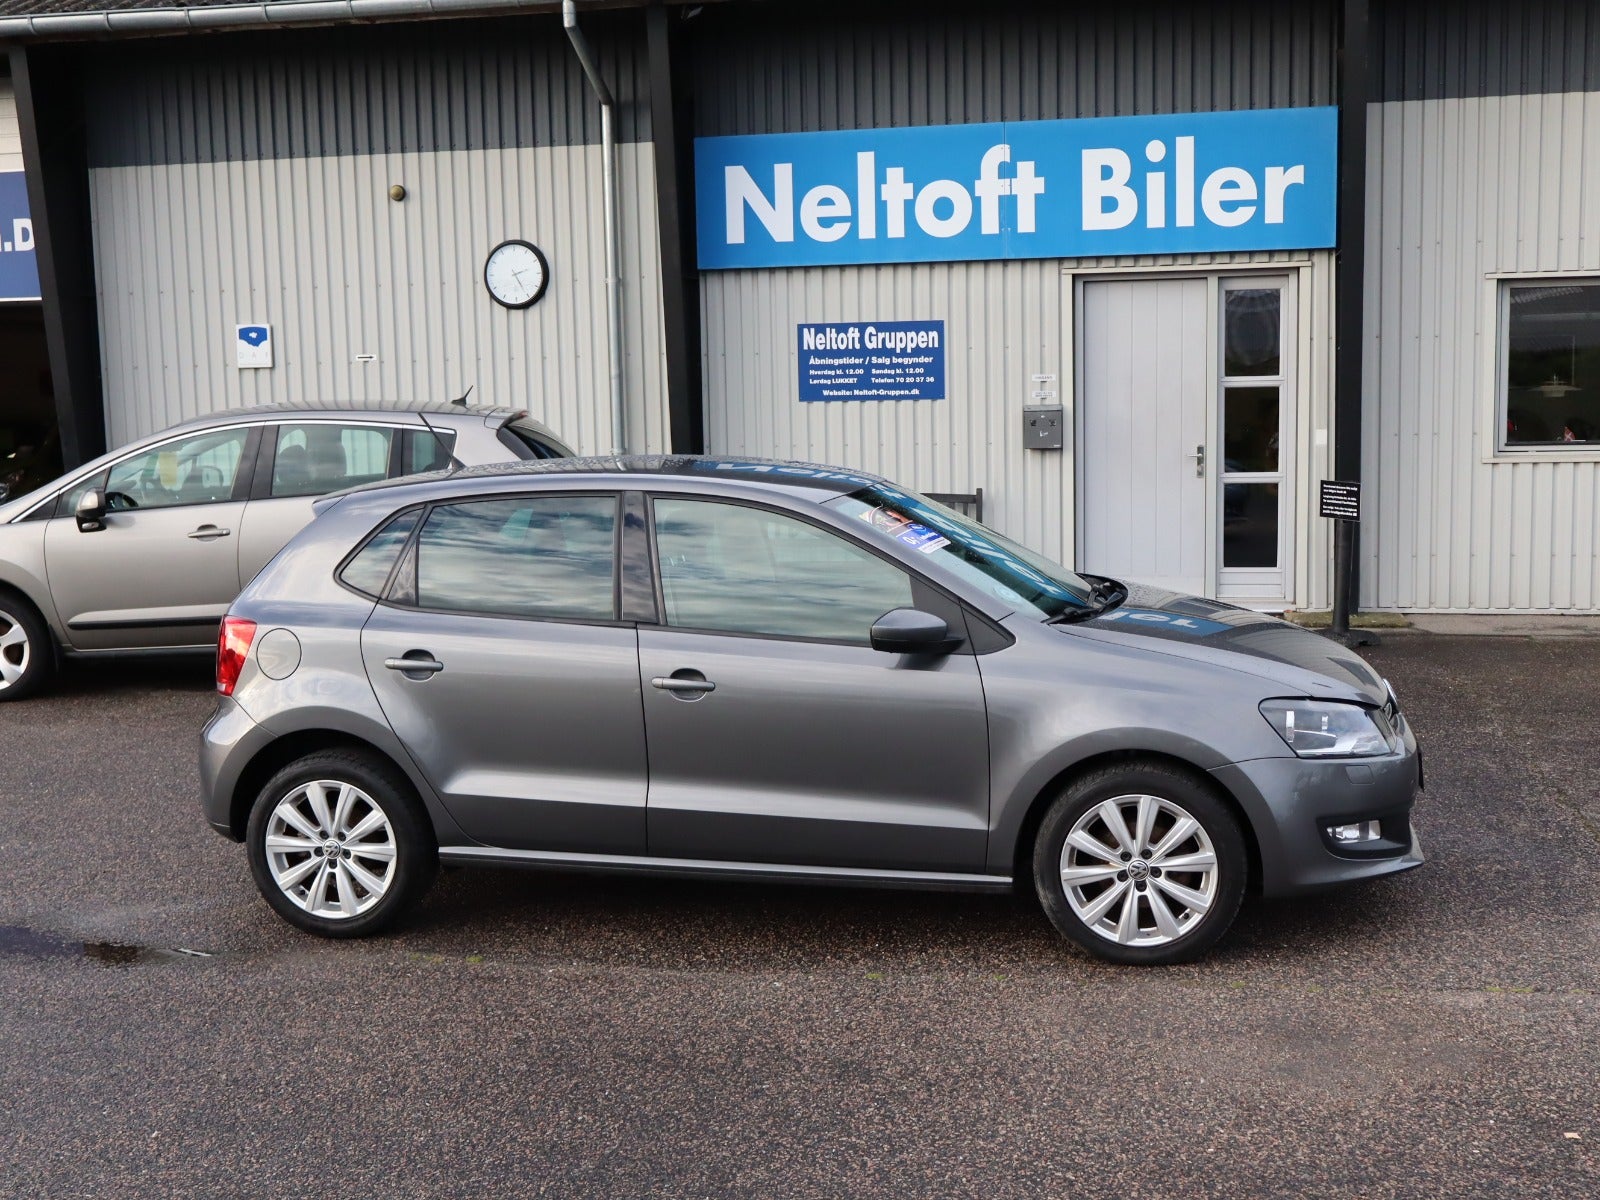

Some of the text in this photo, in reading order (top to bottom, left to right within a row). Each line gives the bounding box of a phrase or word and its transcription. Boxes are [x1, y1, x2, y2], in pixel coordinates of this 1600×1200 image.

[724, 136, 1304, 245] Neltoft Biler
[803, 326, 939, 353] Neltoft Gruppen
[809, 355, 863, 365] Åbningstider
[871, 356, 891, 365] Salg
[892, 355, 934, 365] begynder
[853, 388, 920, 396] Neltoft-Gruppen.dk
